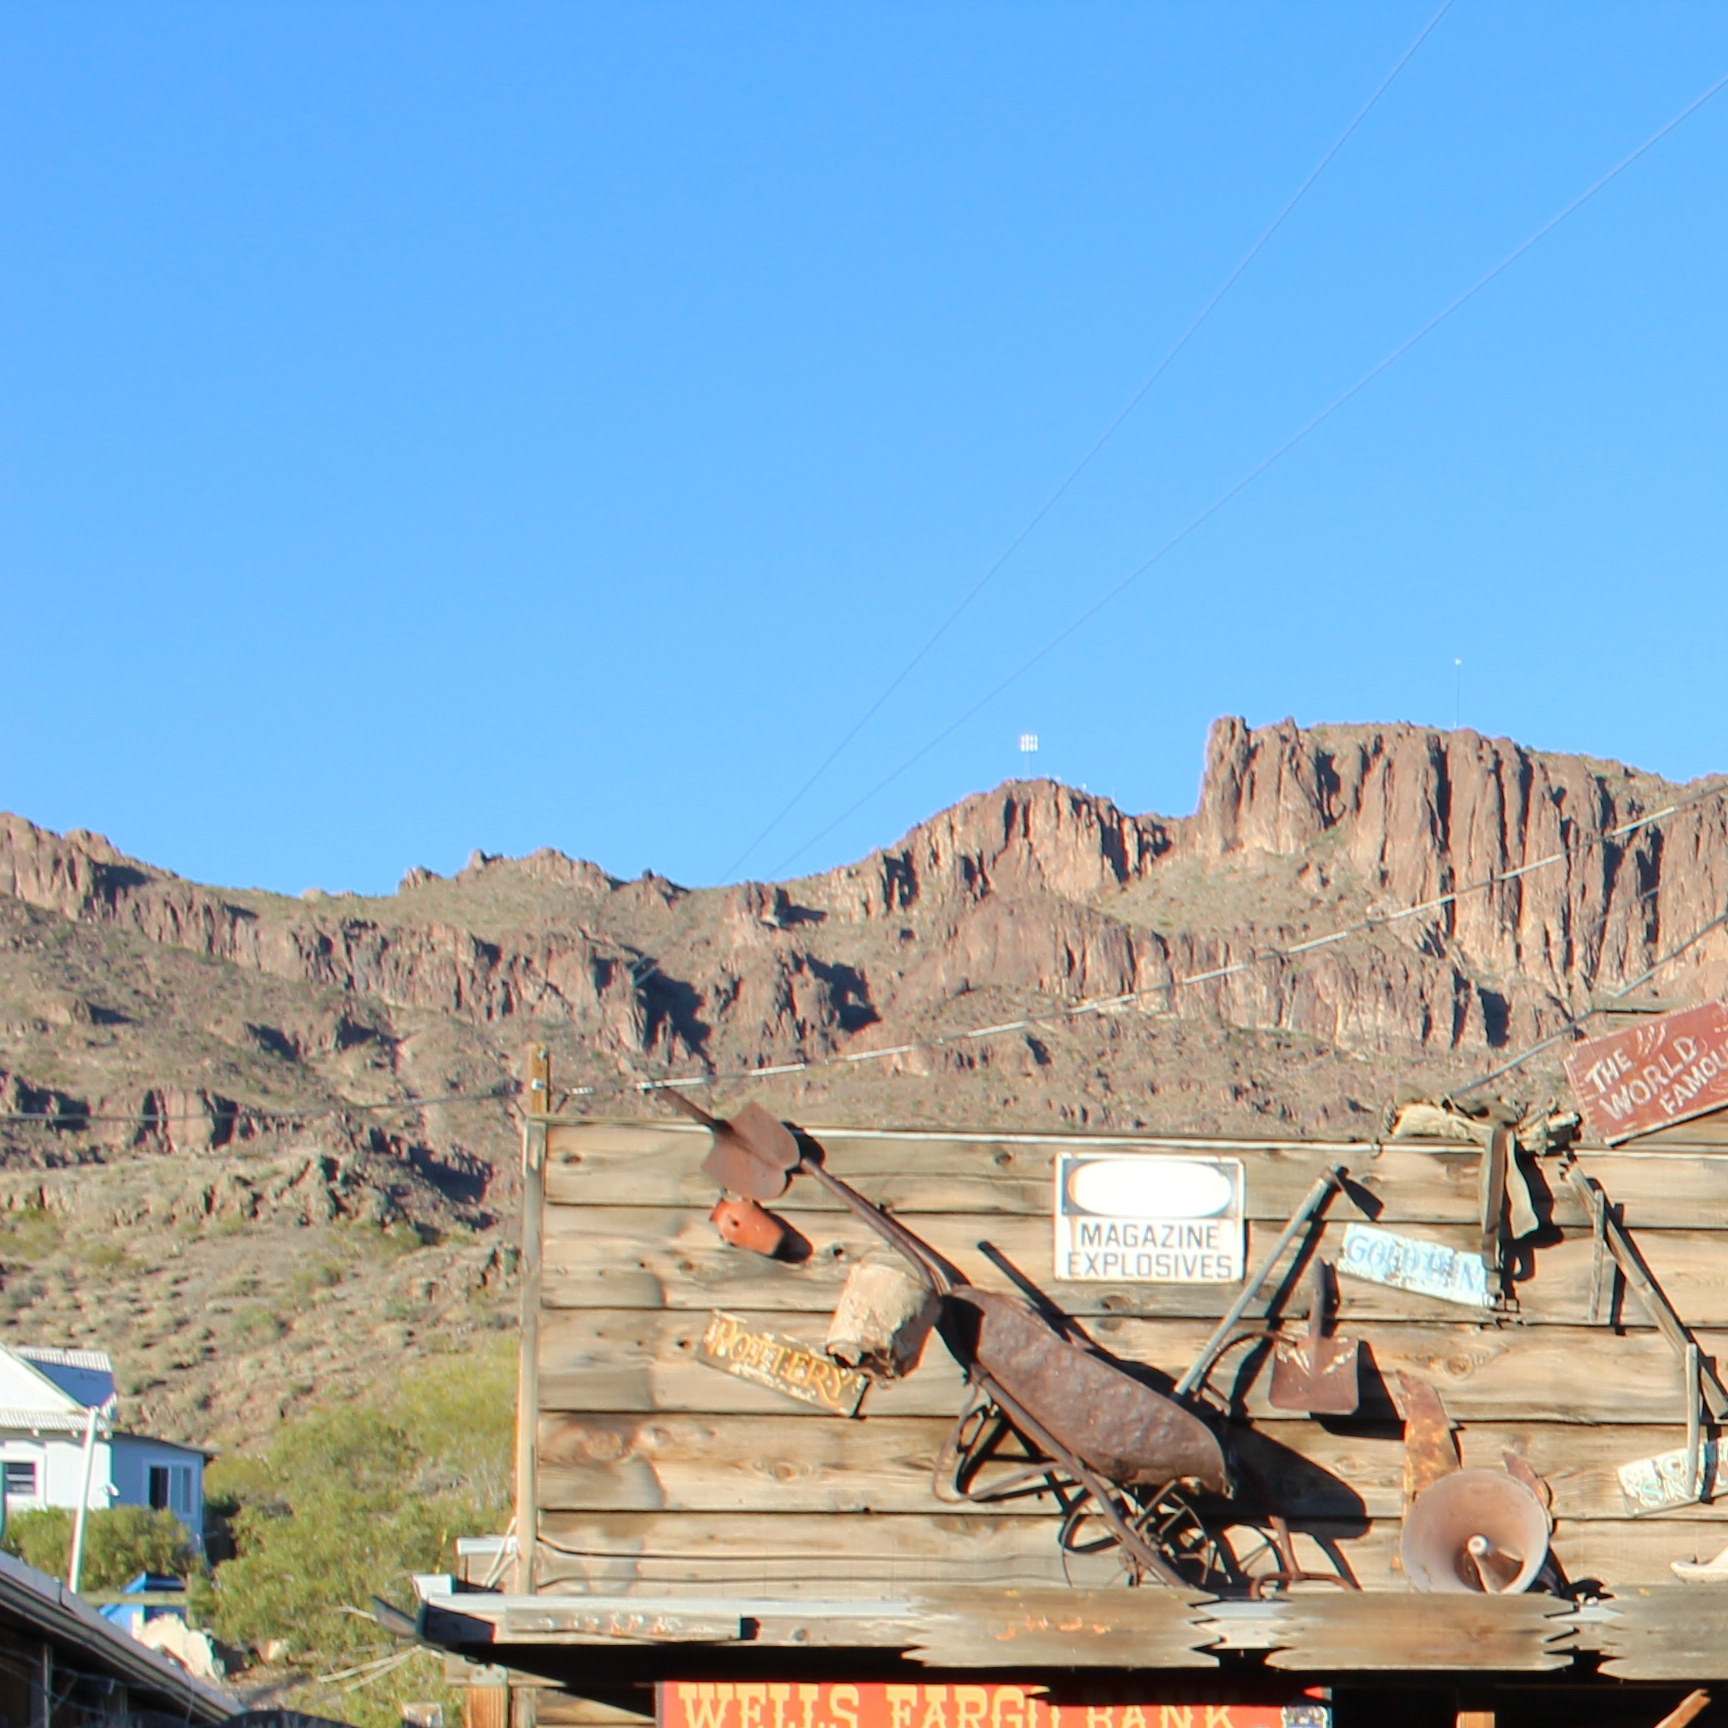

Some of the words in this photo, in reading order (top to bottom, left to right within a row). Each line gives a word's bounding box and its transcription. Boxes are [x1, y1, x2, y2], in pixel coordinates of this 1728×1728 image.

[1585, 1049, 1633, 1094] THE
[1599, 1036, 1698, 1121] WORLD
[1080, 1221, 1220, 1250] MAGAZINE
[1067, 1251, 1233, 1279] EXPLOSIVES
[706, 1320, 856, 1408] POTTERY
